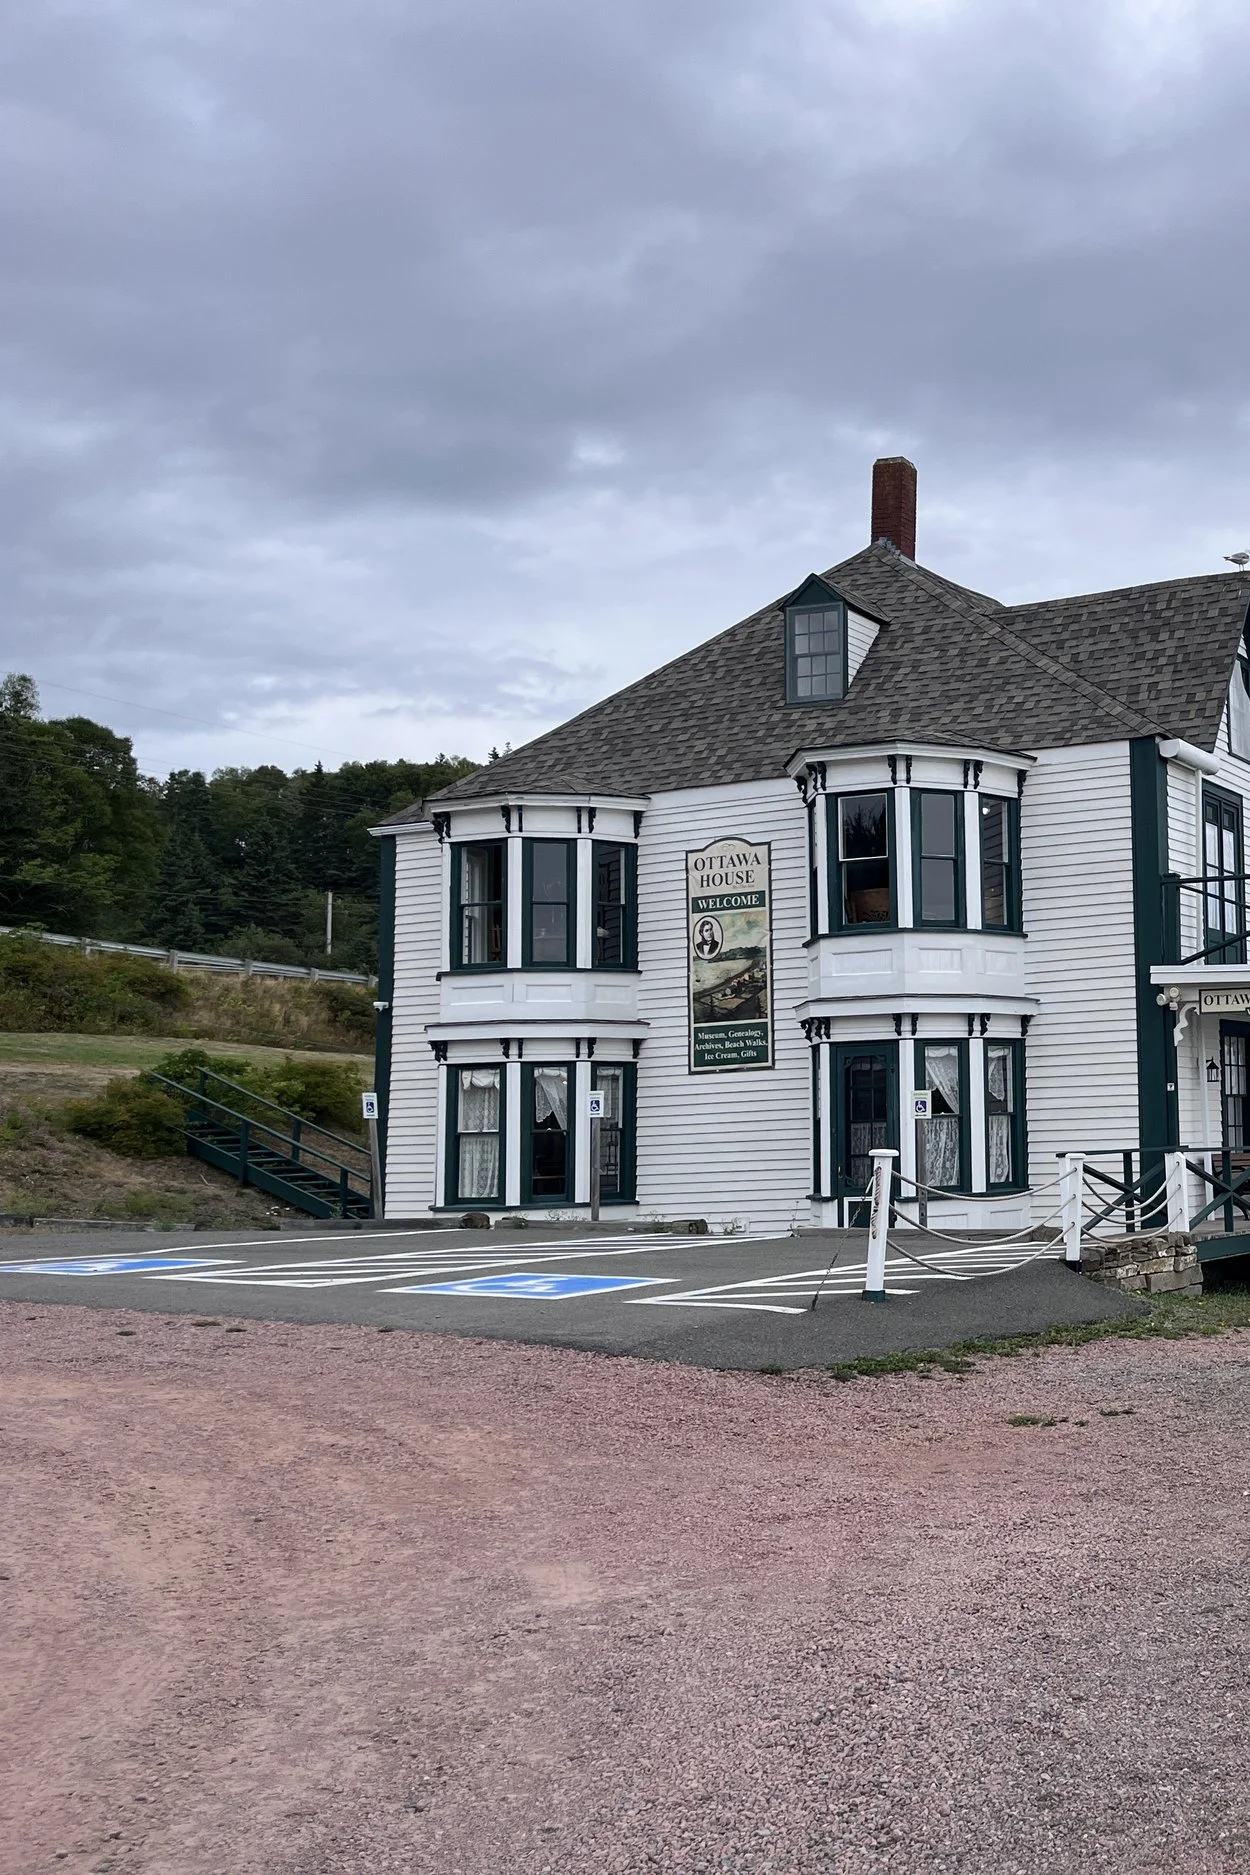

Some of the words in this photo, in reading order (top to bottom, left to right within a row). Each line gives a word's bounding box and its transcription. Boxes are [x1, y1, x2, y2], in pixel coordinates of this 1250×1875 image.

[694, 852, 761, 871] OTTAWA
[700, 869, 755, 888] HOUSE
[698, 894, 759, 909] WELCOME
[728, 1029, 764, 1038] Genealogy,
[695, 1042, 723, 1050] Archives,
[725, 1040, 744, 1048] Beach
